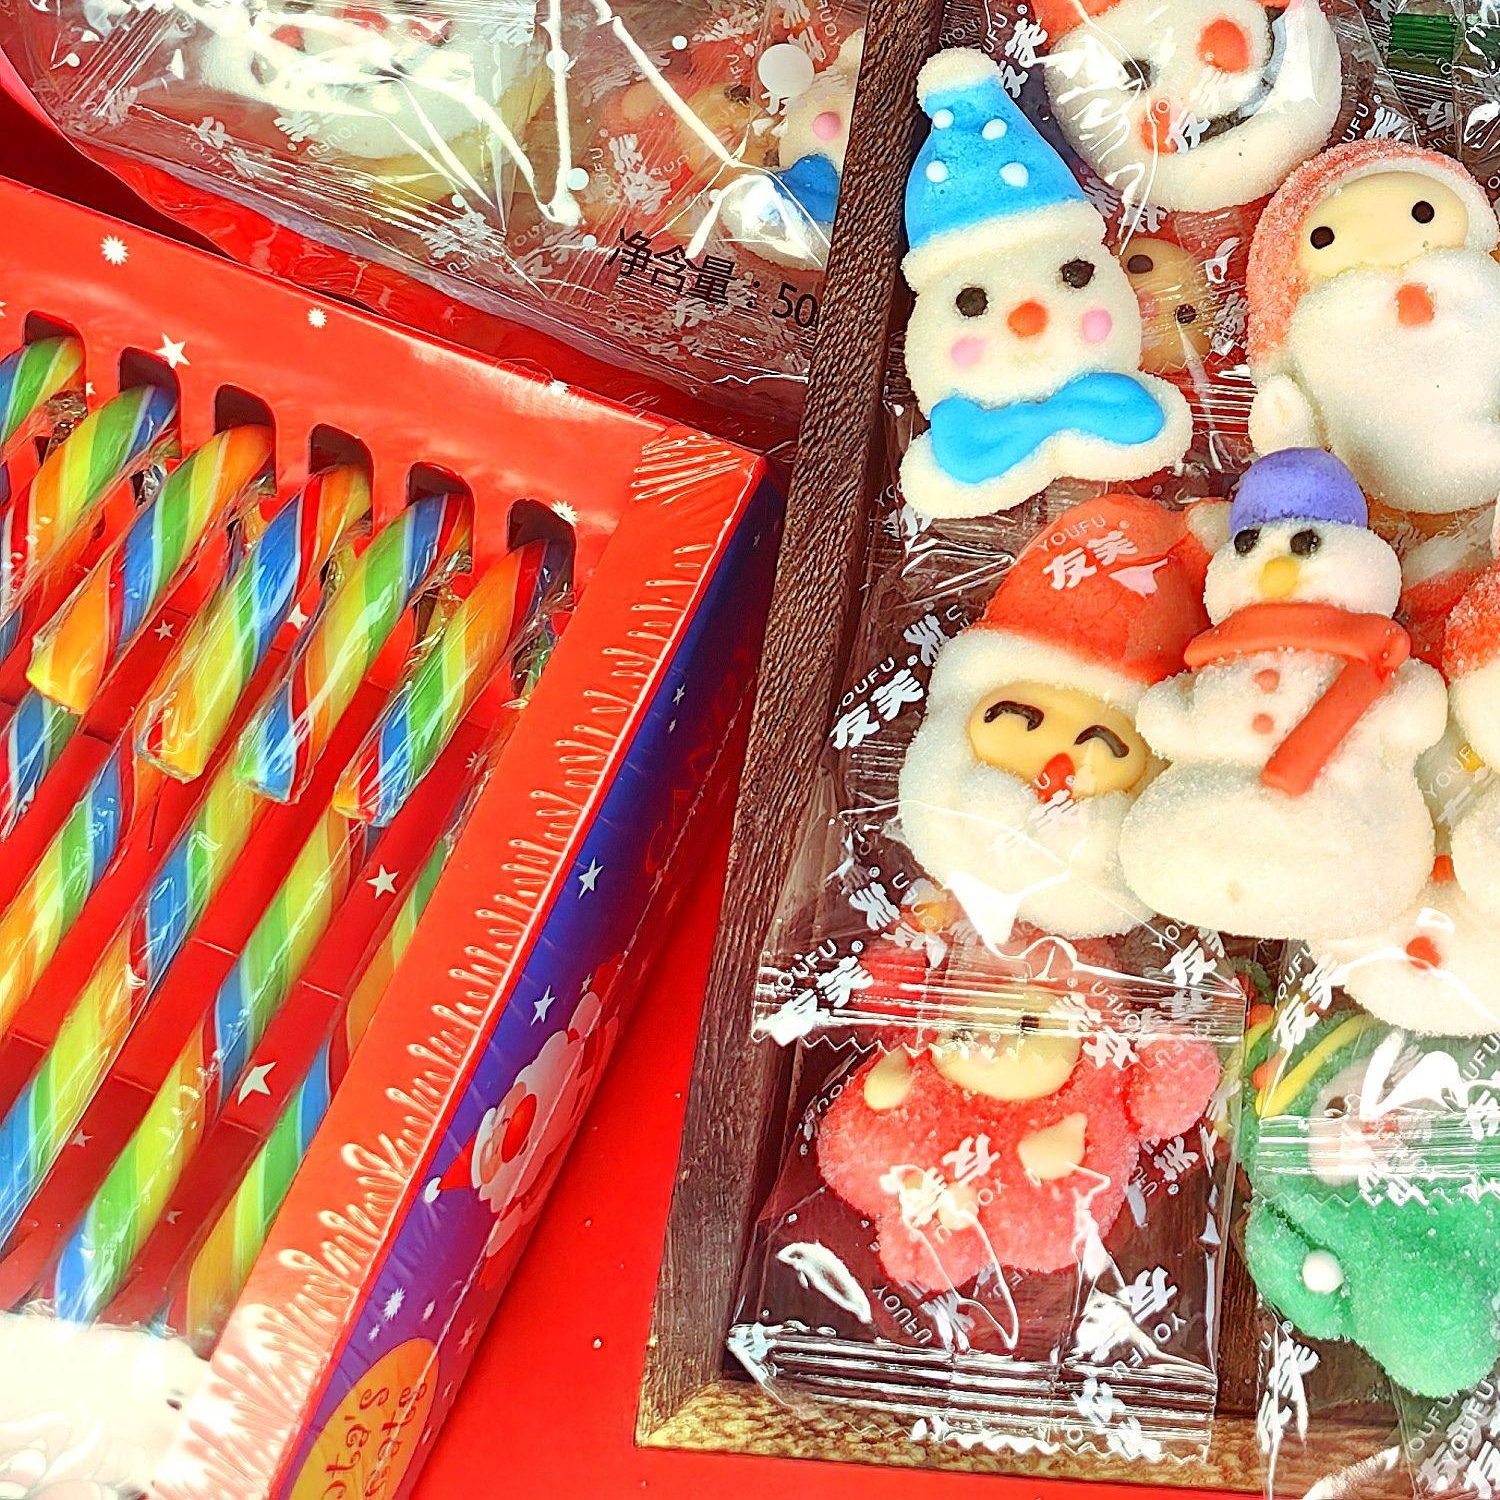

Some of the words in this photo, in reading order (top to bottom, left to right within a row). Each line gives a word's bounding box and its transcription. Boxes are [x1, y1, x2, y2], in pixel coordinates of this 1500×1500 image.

[1036, 513, 1107, 553] YOUFU
[1043, 530, 1139, 591] 友芙
[831, 669, 924, 752] 友芙
